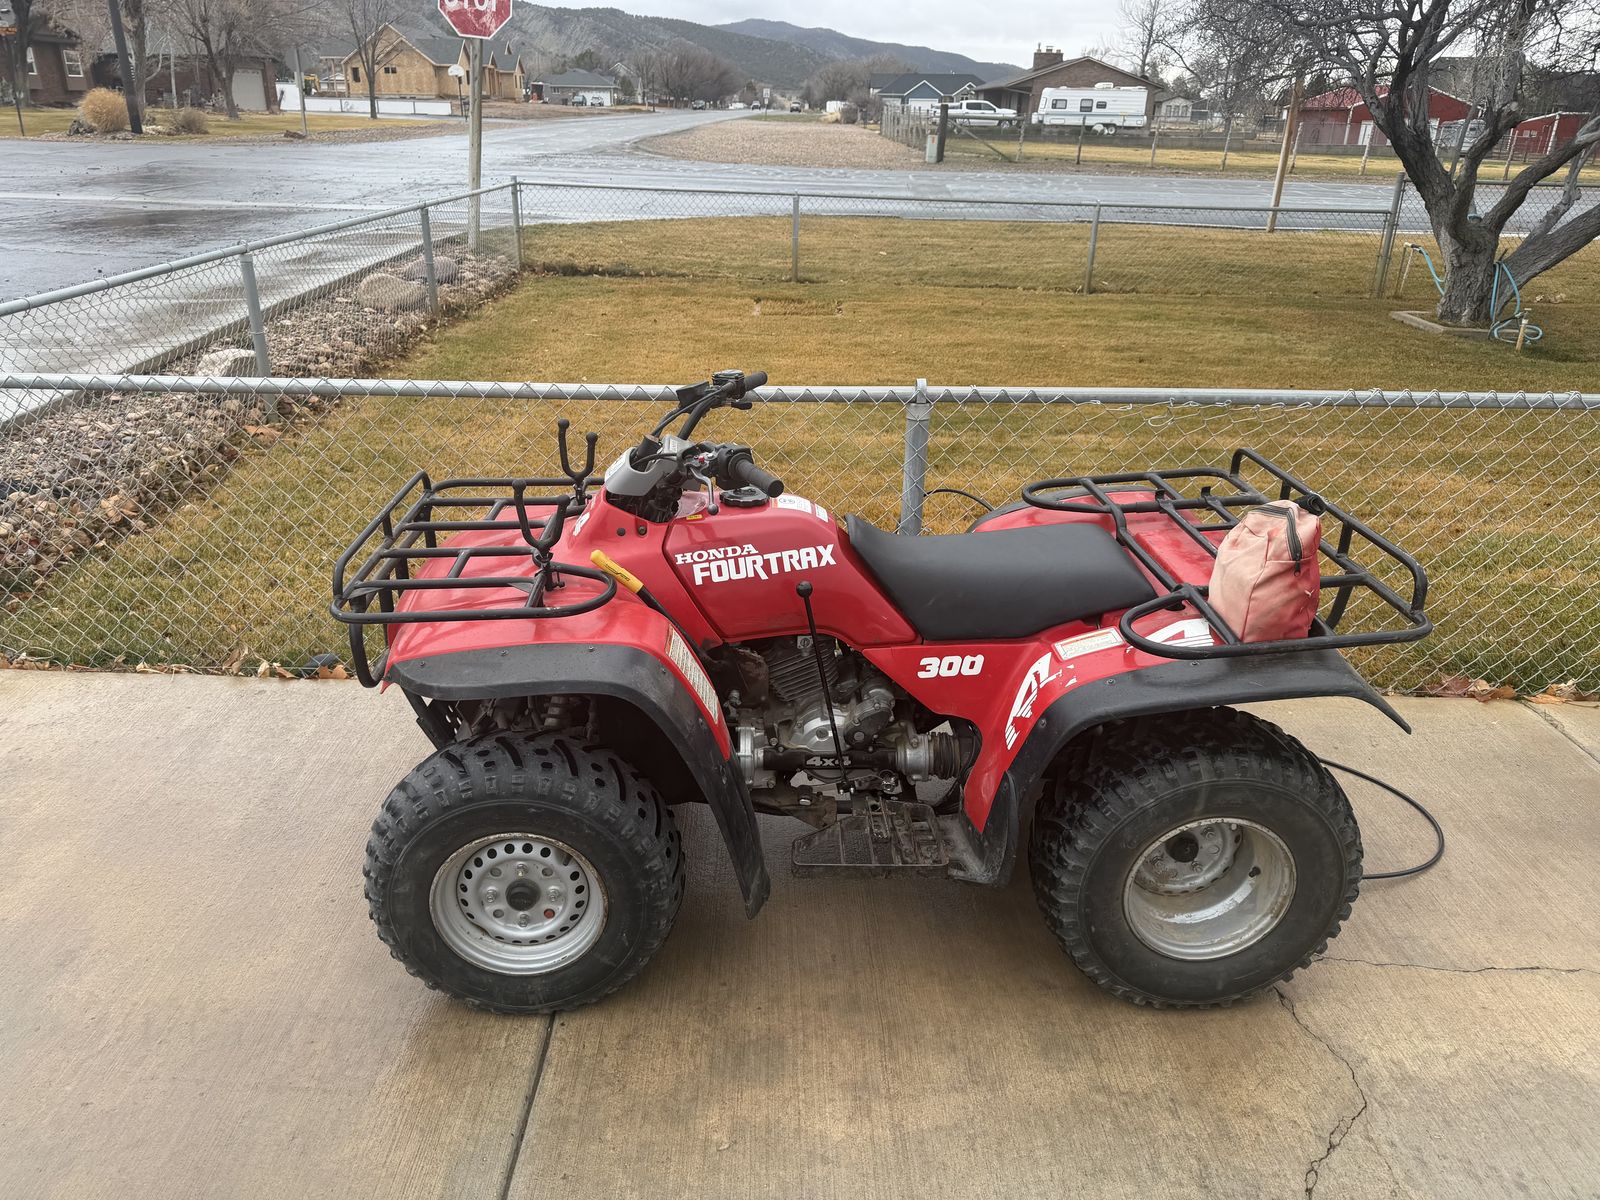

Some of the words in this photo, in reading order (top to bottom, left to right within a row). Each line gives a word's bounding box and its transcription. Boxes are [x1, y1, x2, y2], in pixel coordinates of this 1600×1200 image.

[675, 544, 759, 565] HONDA
[692, 544, 837, 586] FOURTRAX
[918, 654, 985, 679] 300
